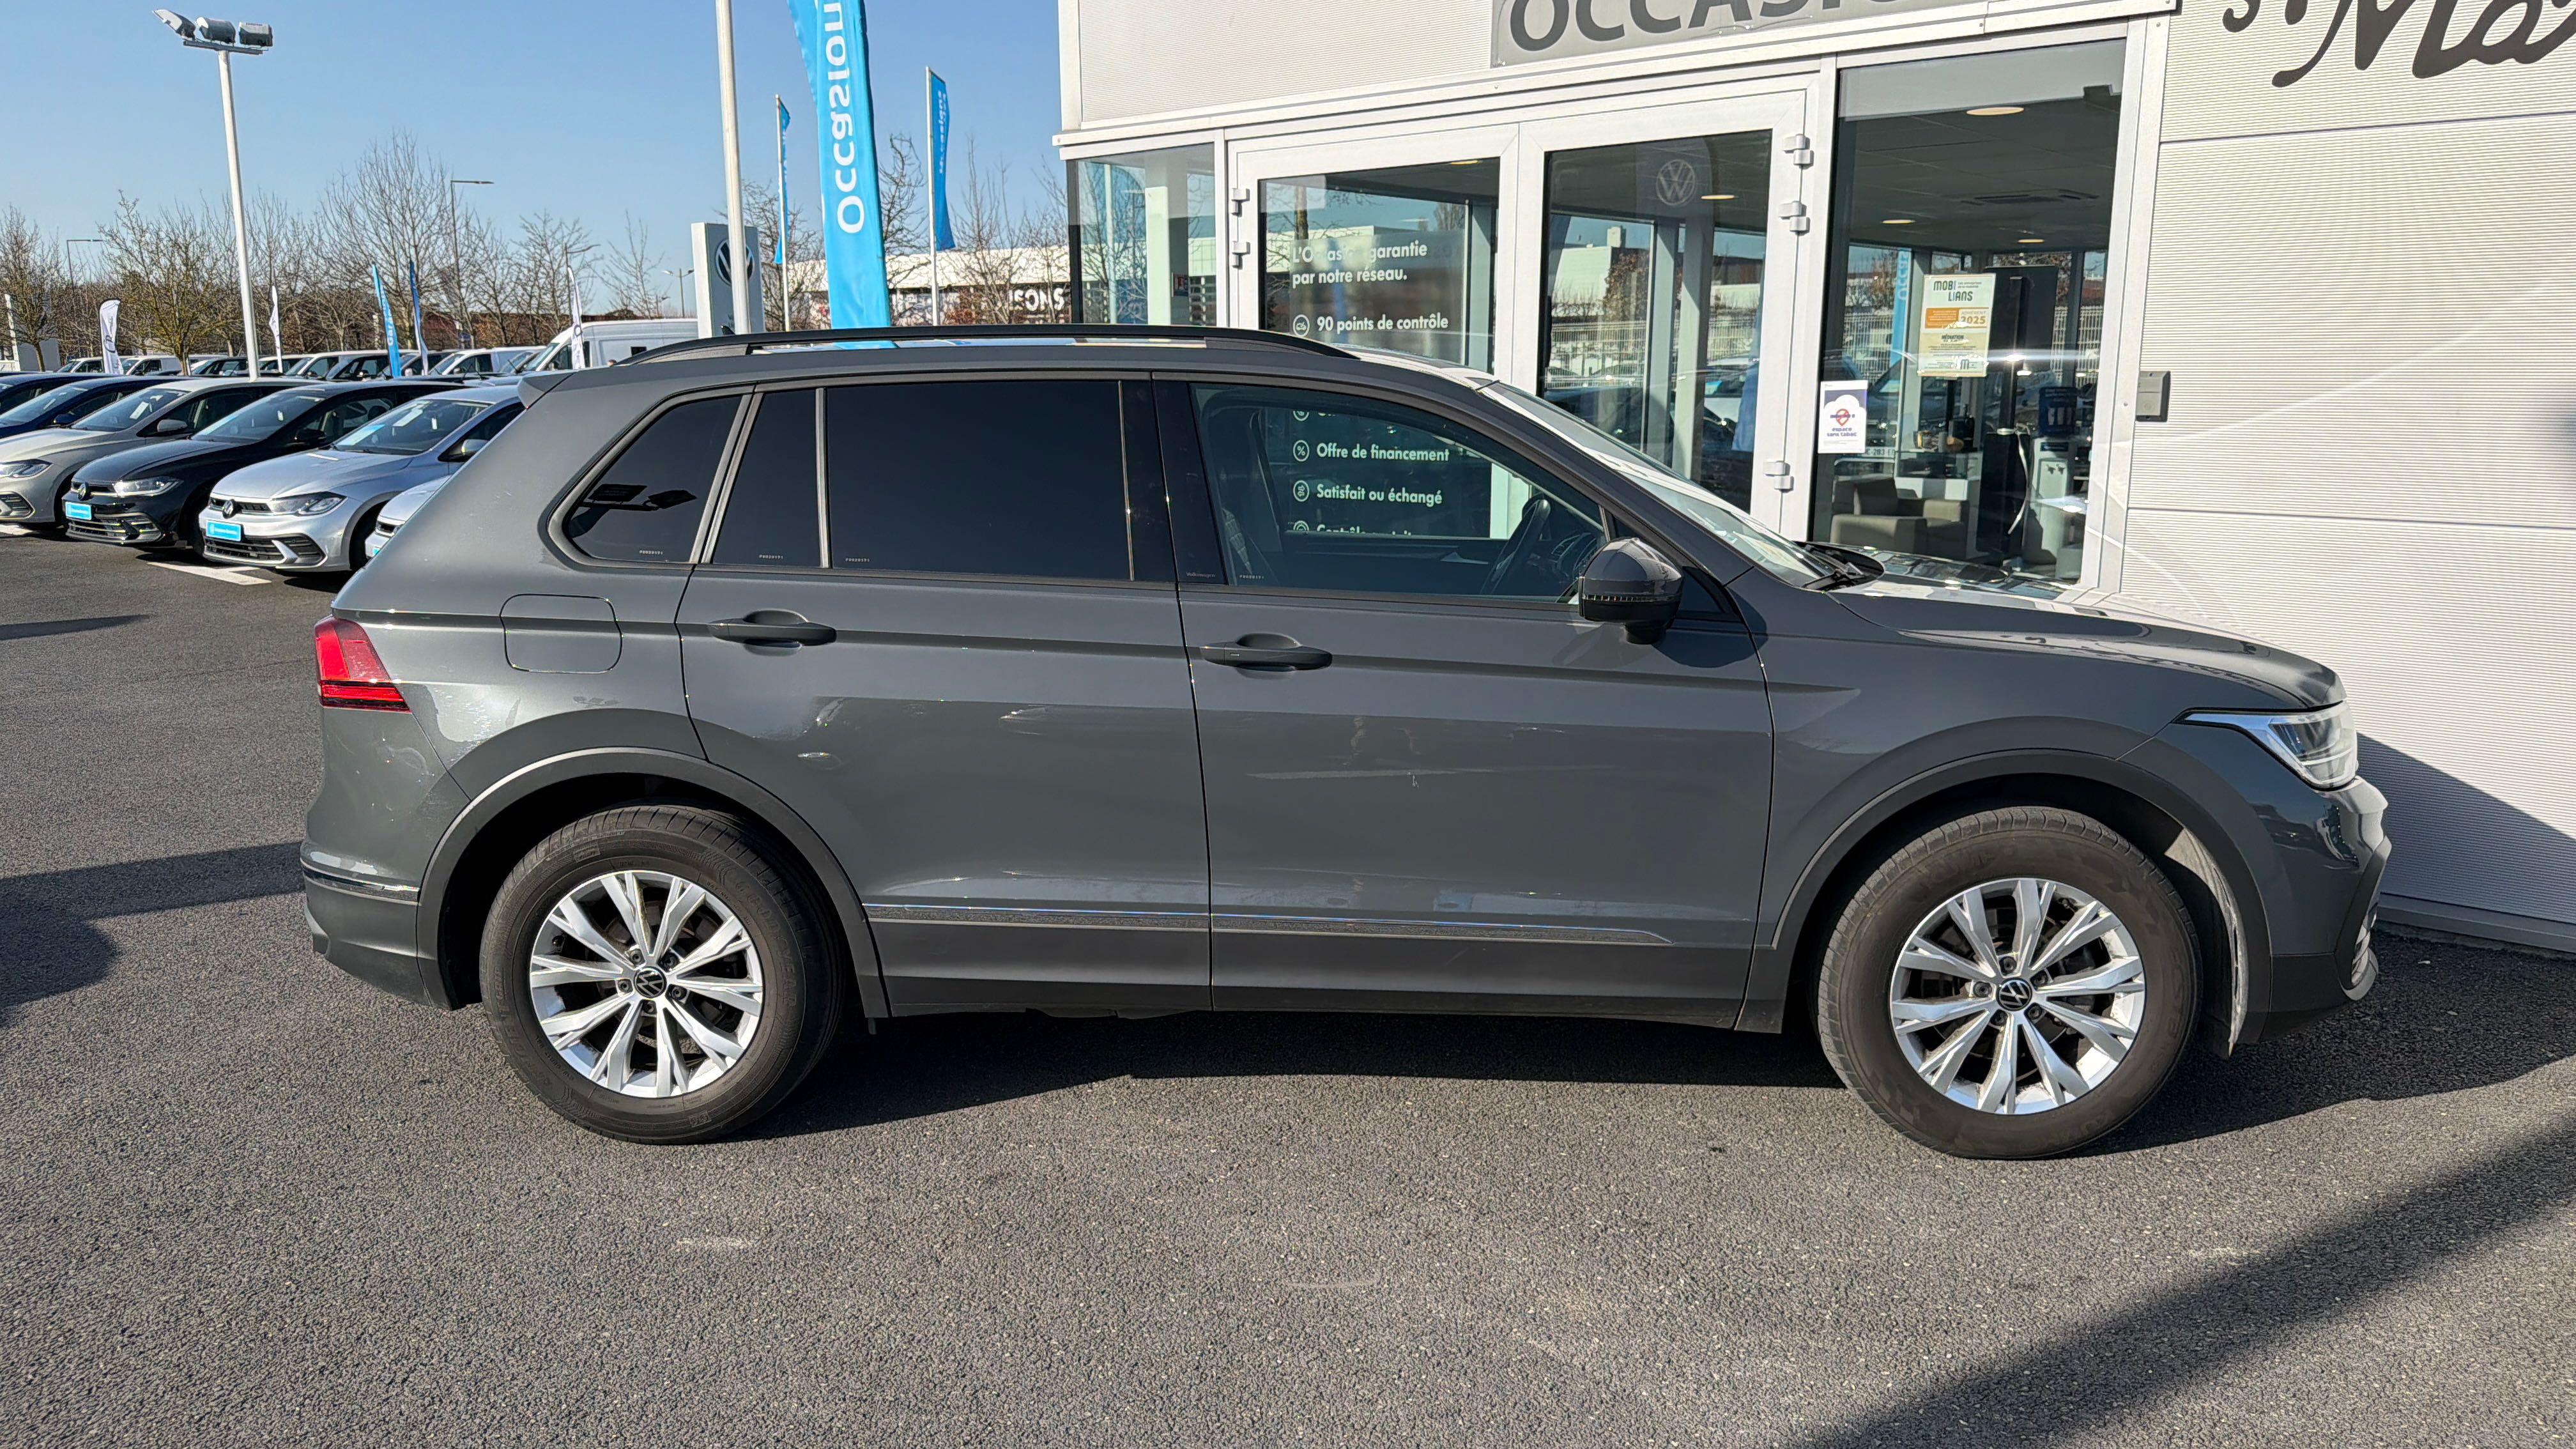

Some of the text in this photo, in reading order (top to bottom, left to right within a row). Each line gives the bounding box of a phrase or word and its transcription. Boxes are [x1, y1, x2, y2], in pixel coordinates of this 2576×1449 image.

[1370, 240, 1428, 263] garantie
[1292, 264, 1407, 289] par notre réseau.
[1317, 312, 1448, 334] 90 points de contrôle
[1961, 316, 1986, 324] 2025
[1316, 442, 1450, 461] Offre de financement
[1317, 484, 1443, 507] Satisfait ou échangé
